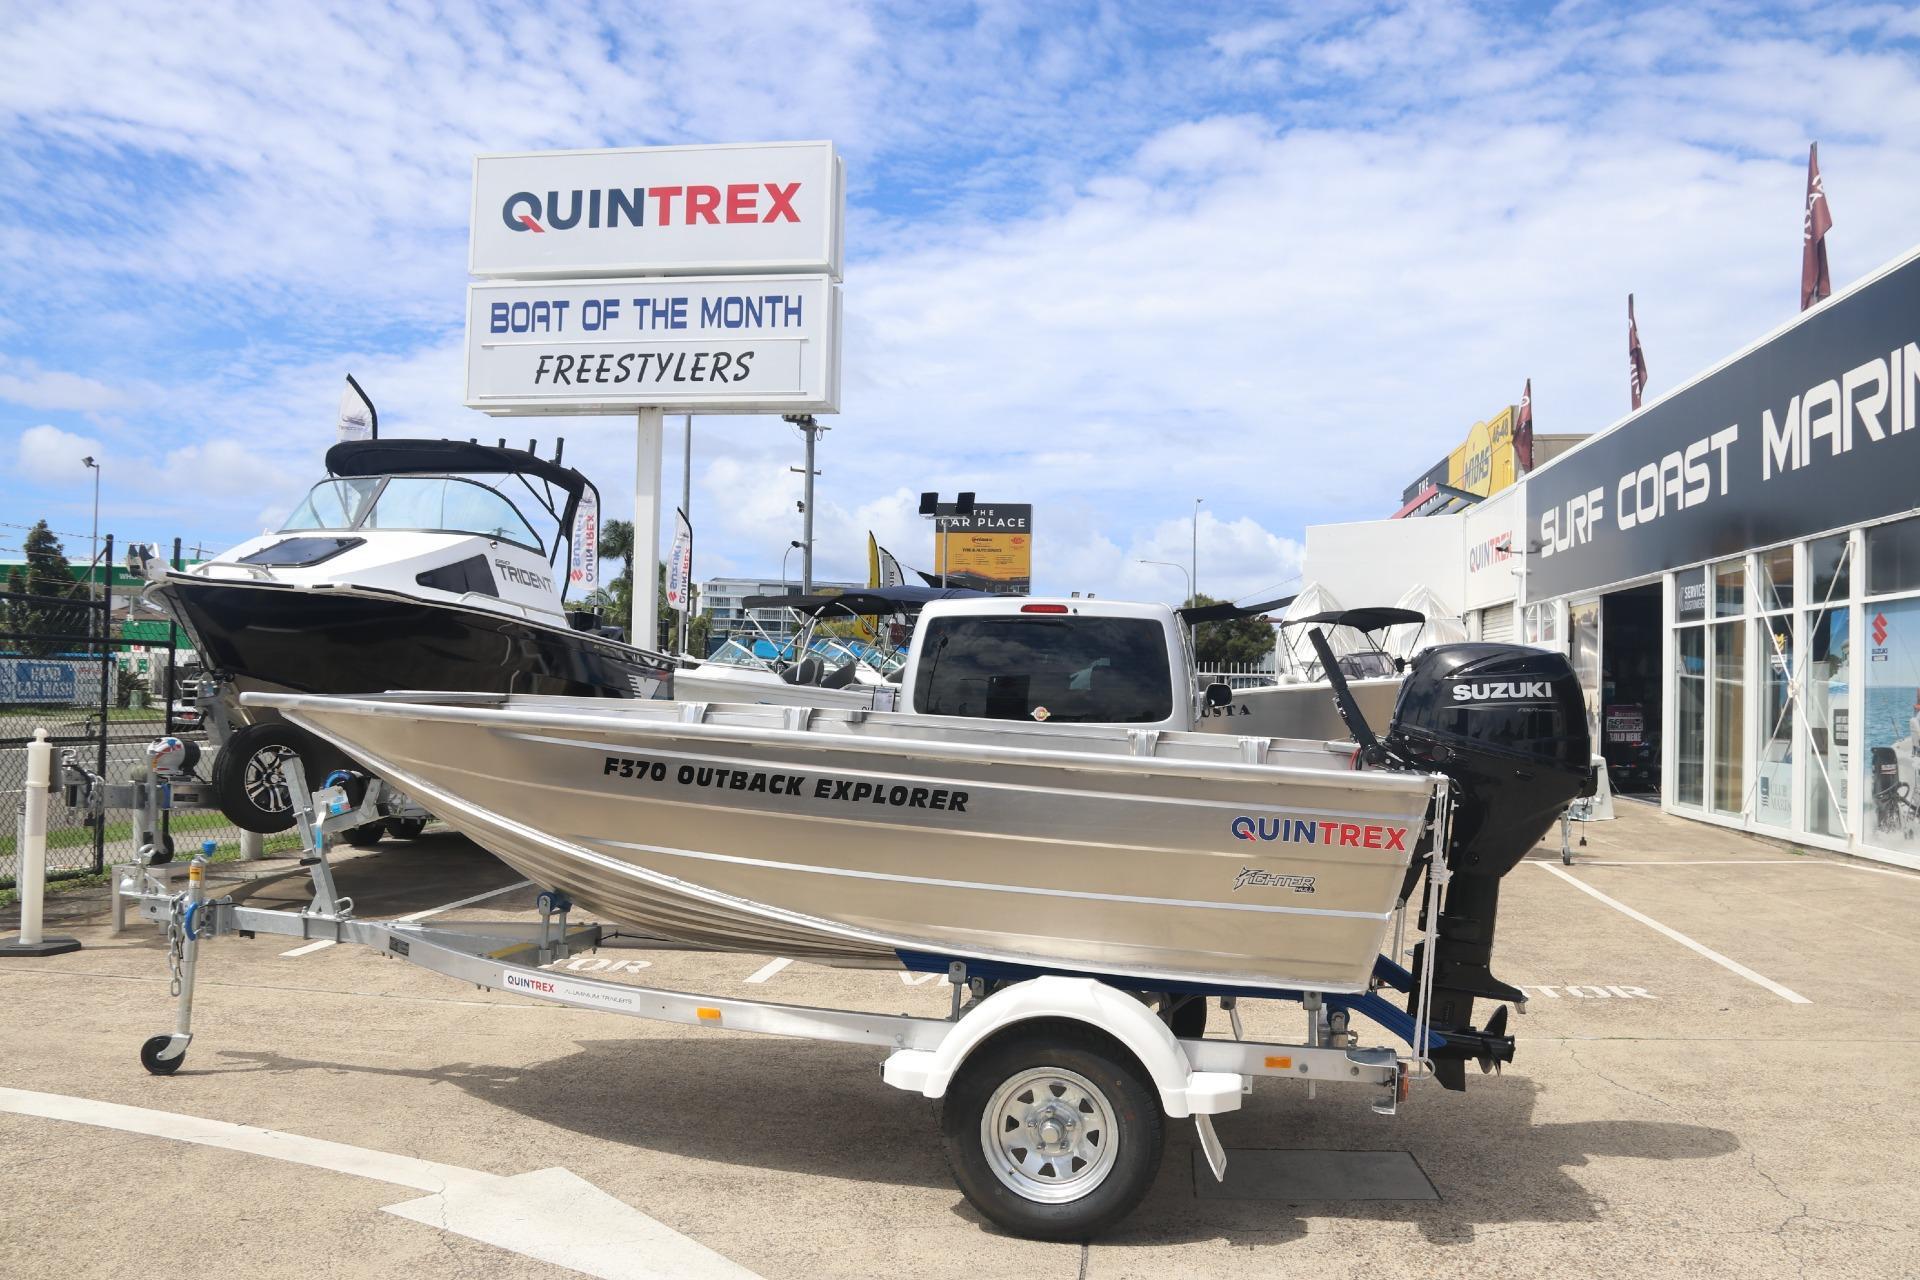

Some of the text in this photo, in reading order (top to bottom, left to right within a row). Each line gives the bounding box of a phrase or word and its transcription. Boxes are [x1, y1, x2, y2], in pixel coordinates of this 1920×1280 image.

[502, 182, 802, 233] QUINTREX
[490, 295, 802, 334] BOAT OF THE MONTH
[535, 351, 755, 385] FREESTYLERS
[1465, 445, 1490, 489] MIDAS
[1541, 486, 1604, 559] SURF
[1617, 423, 1738, 531] COAST
[977, 518, 1025, 528] PLACE
[495, 563, 553, 593] TRIDENT
[1684, 583, 1705, 599] SERVICE
[31, 667, 61, 680] HAND
[42, 681, 73, 696] WASH
[1453, 682, 1552, 701] SUZUKI
[604, 757, 969, 812] F370 OUTBACK EXPLORER
[1231, 816, 1408, 851] QUINTREX
[1233, 867, 1316, 890] FIGHTER
[507, 975, 555, 993] QUINTREX
